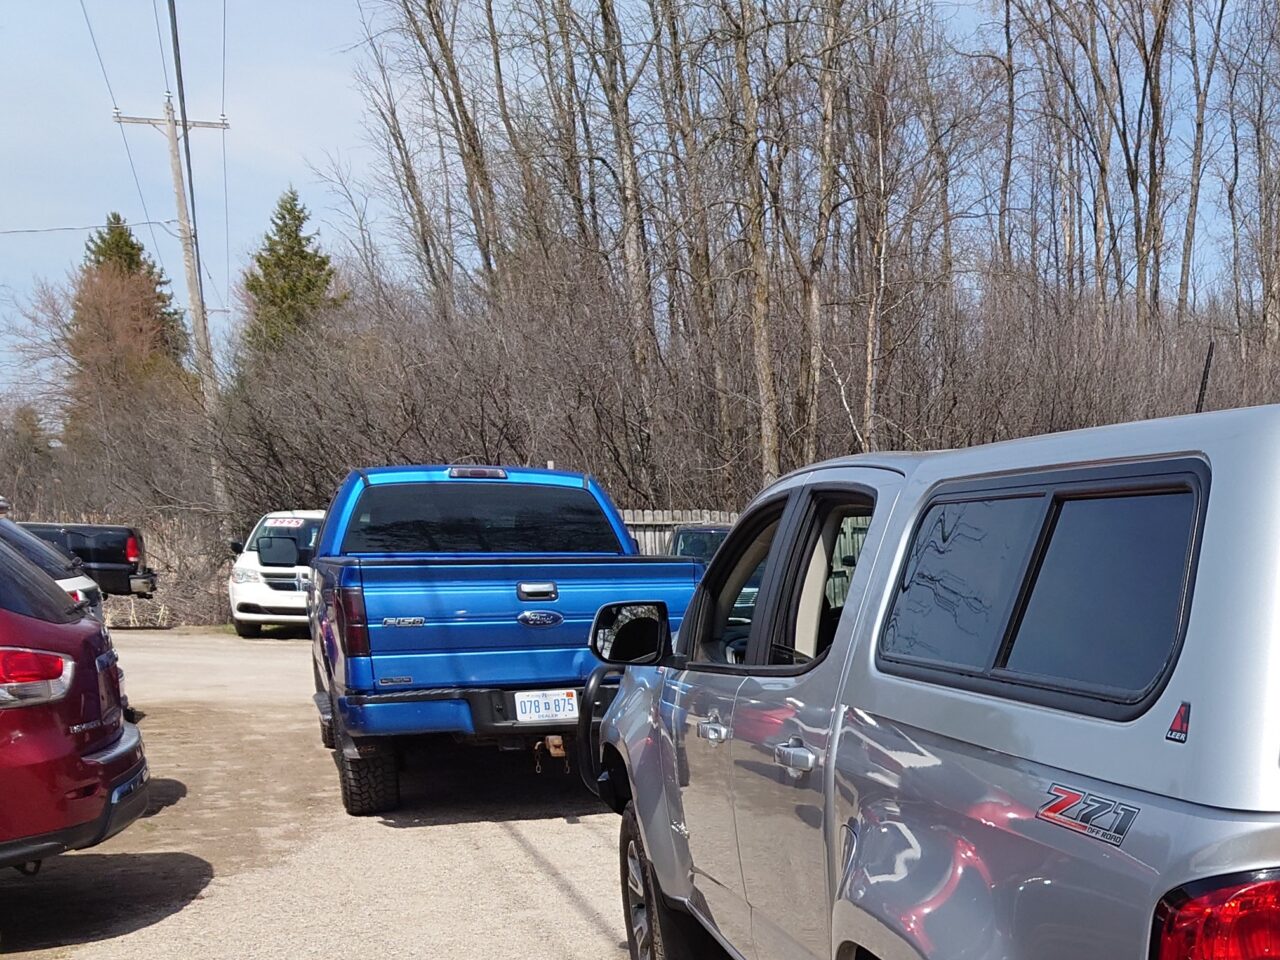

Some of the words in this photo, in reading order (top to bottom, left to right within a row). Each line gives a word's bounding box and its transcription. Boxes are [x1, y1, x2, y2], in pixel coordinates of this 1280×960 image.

[528, 613, 553, 624] Ford
[520, 700, 541, 714] 078
[544, 702, 550, 711] D
[554, 698, 574, 712] 875
[1167, 730, 1187, 742] LEER
[1036, 782, 1141, 836] Z71
[1086, 826, 1102, 838] OFF
[1101, 831, 1122, 844] ROAD
